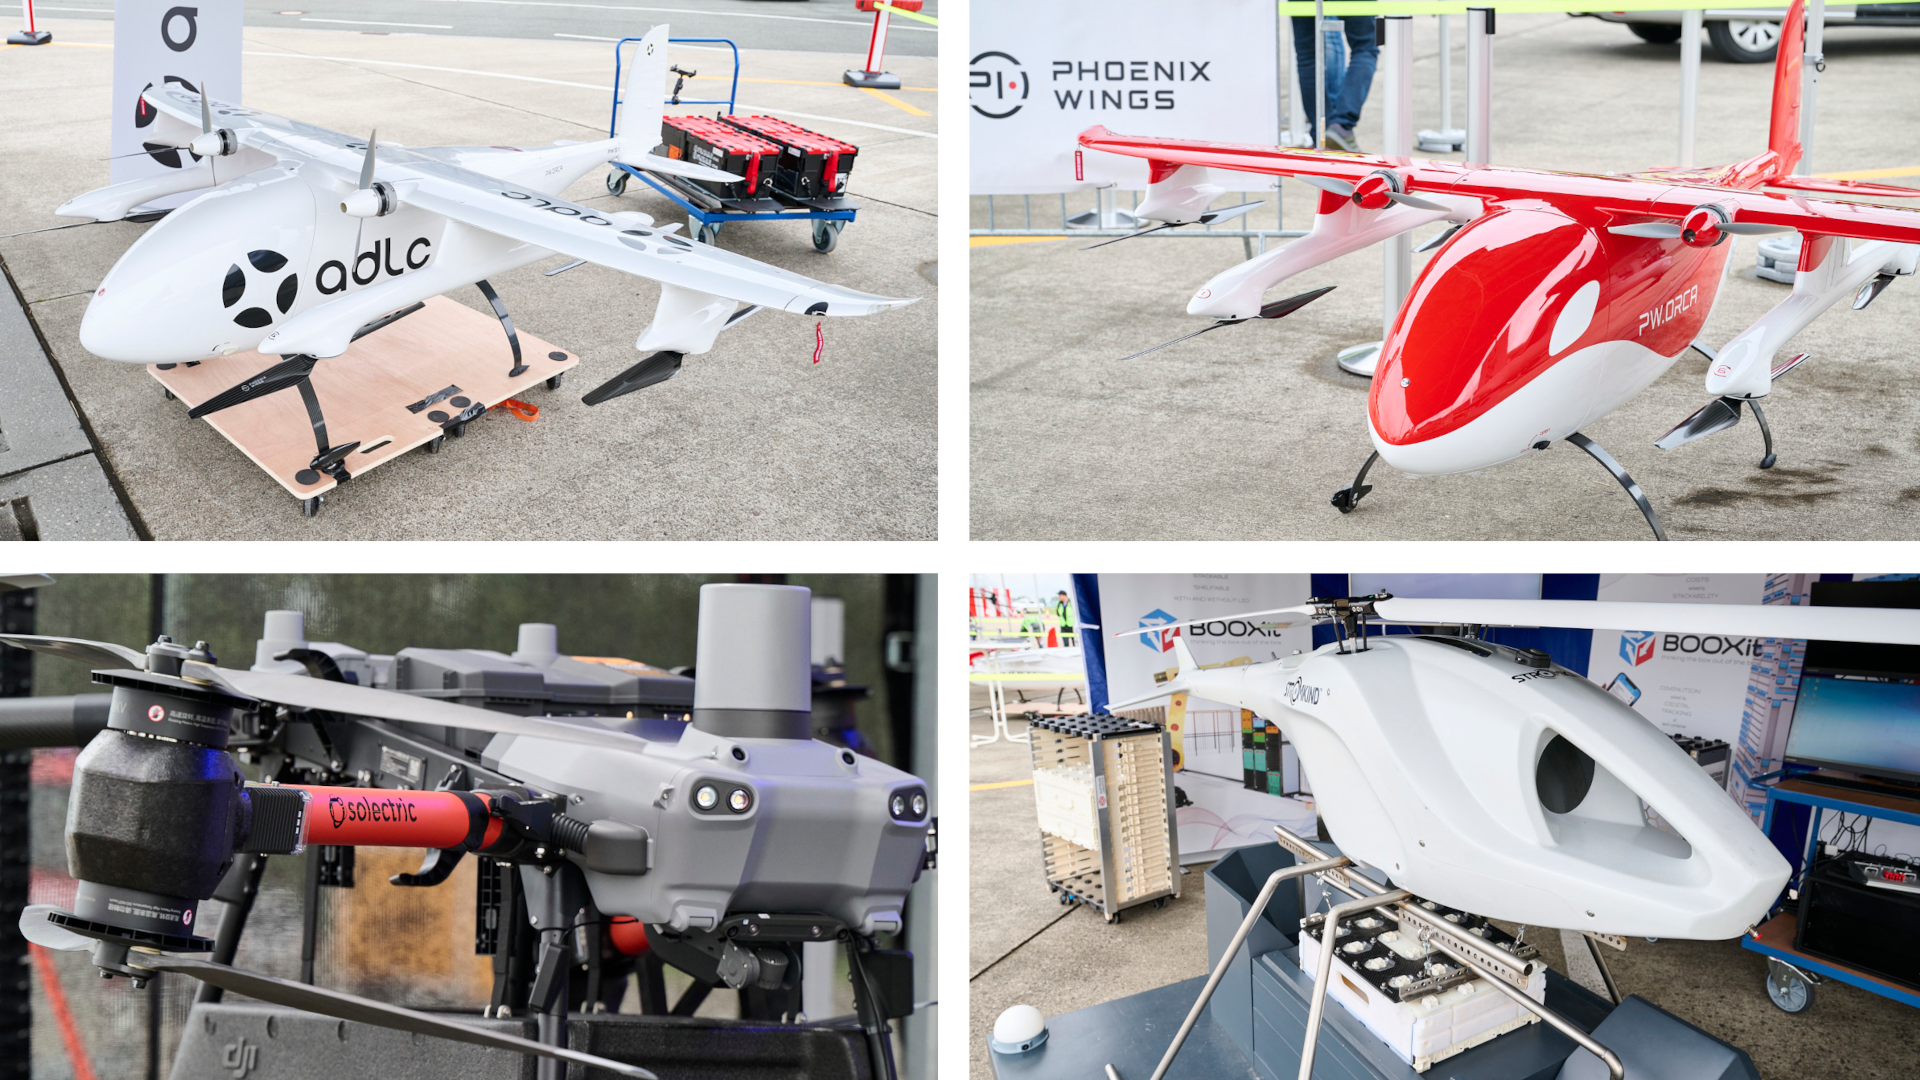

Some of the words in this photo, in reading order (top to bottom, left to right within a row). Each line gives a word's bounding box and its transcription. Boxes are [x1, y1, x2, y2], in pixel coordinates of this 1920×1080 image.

[1053, 61, 1211, 82] PHOENIX
[1055, 90, 1175, 110] WINGS
[316, 237, 431, 295] adlc
[1639, 284, 1698, 336] PW.ORCA
[1662, 634, 1762, 657] BOOXit
[1661, 654, 1685, 662] thinking
[348, 796, 417, 822] solectric
